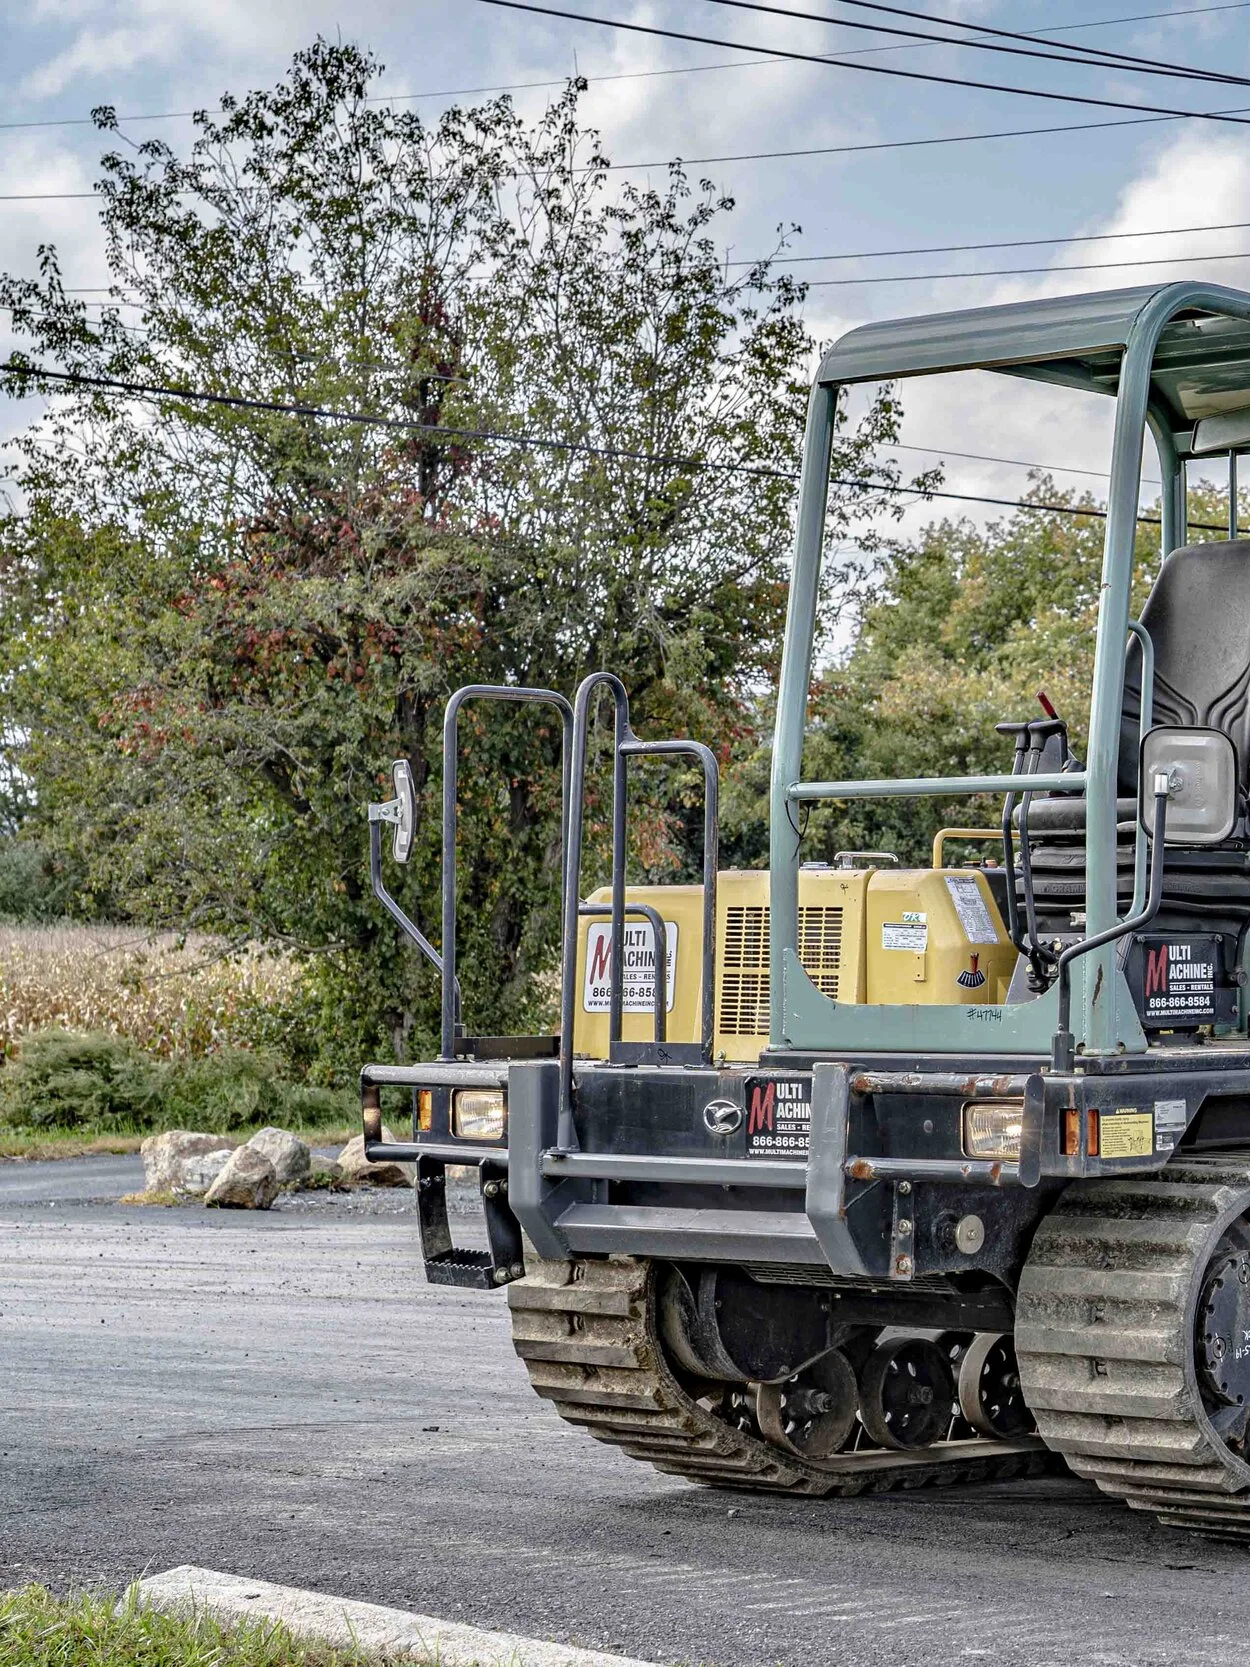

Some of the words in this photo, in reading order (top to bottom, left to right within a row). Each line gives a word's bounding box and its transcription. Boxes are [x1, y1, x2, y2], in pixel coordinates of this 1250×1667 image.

[1149, 996, 1210, 1008] 866-866-8584
[776, 1123, 796, 1131] SALES
[753, 1136, 810, 1147] 866-866-85
